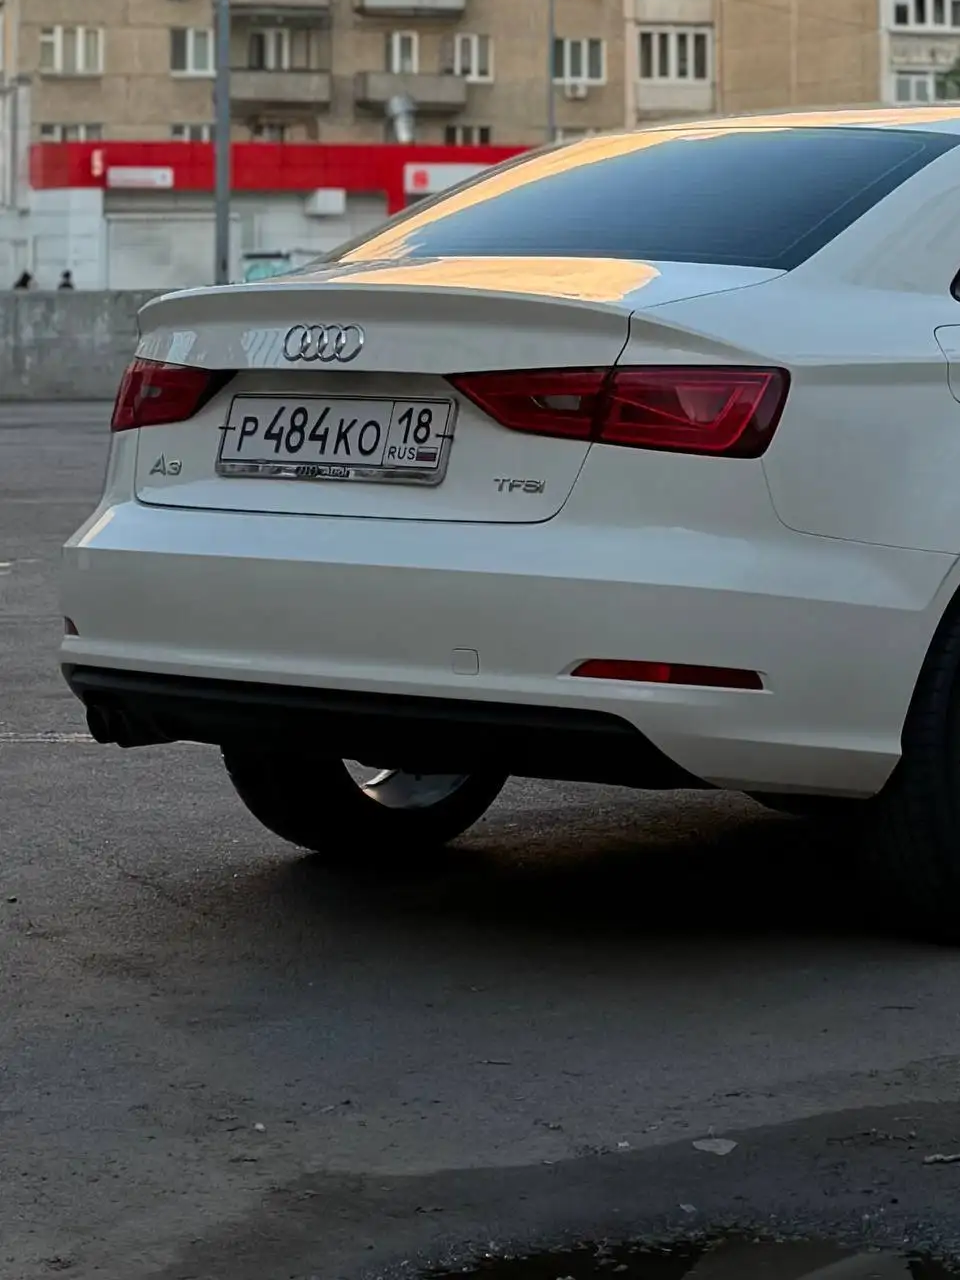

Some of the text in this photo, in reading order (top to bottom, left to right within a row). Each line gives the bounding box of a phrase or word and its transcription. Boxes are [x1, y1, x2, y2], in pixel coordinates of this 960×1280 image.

[397, 407, 434, 445] 18
[387, 446, 416, 461] RUS
[149, 452, 182, 476] A3
[493, 478, 546, 494] TFSI
